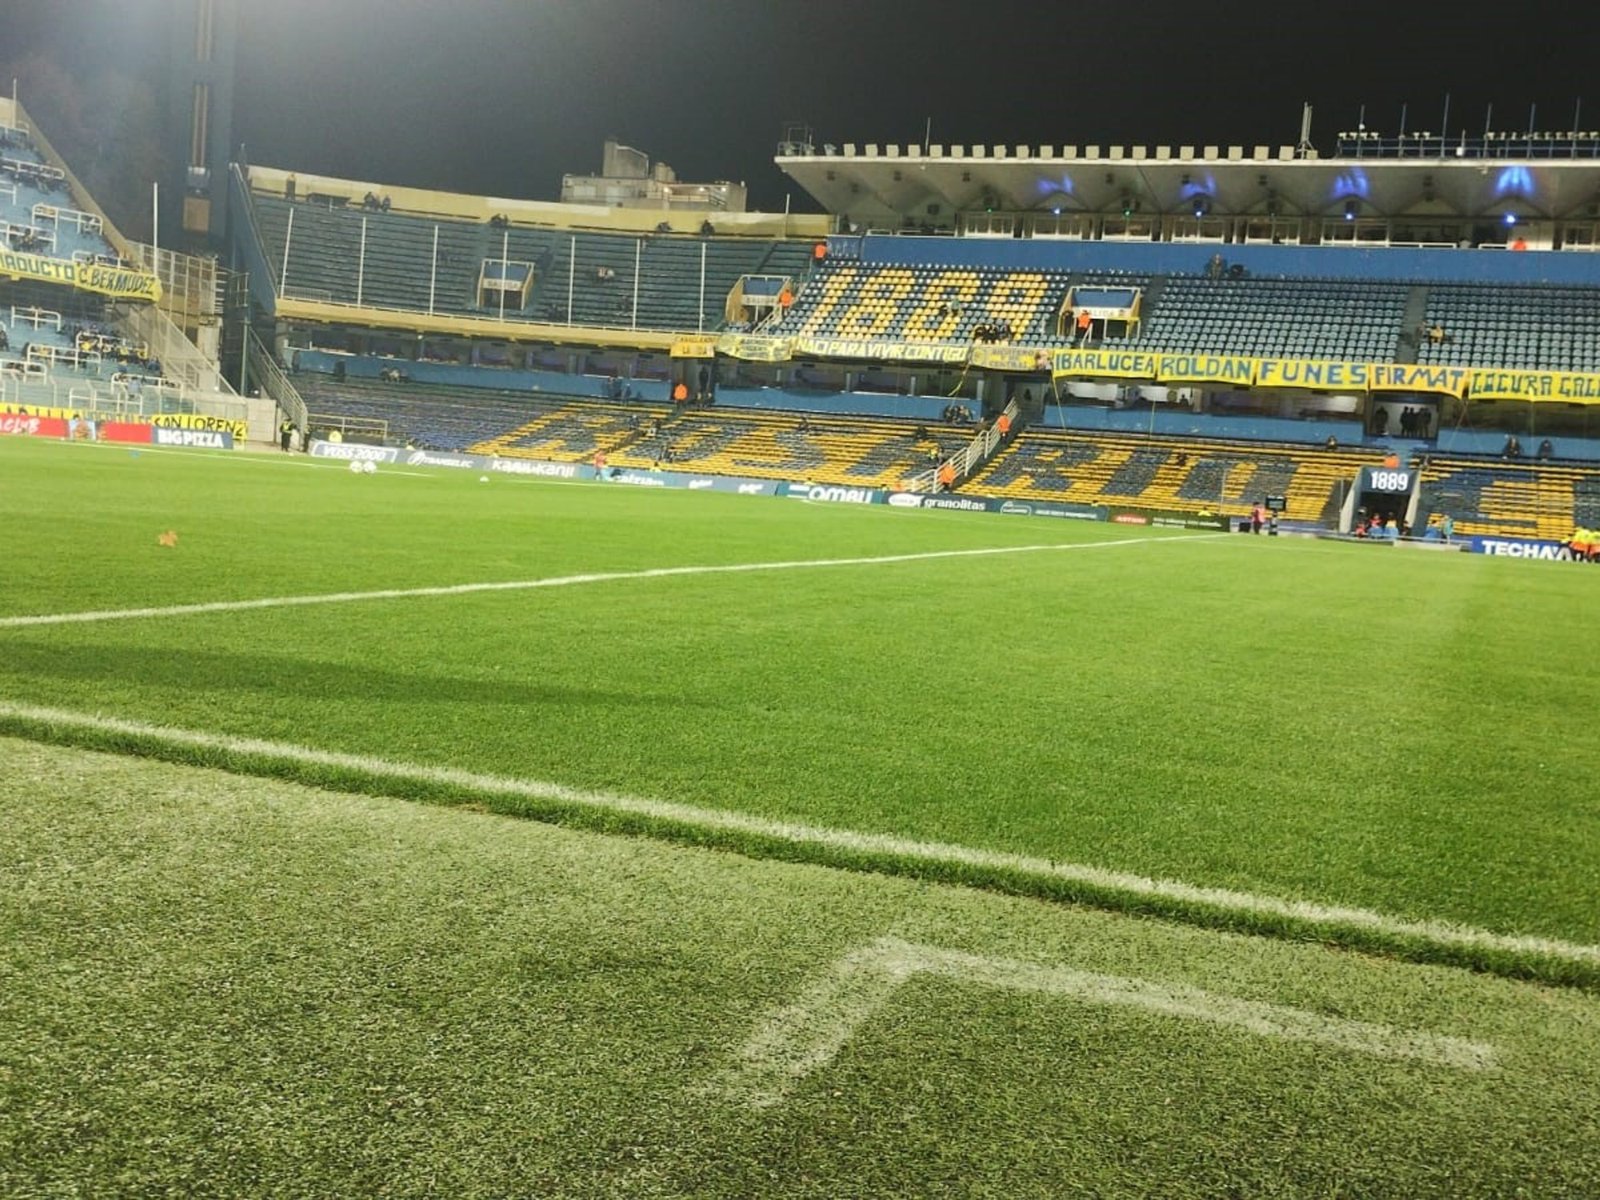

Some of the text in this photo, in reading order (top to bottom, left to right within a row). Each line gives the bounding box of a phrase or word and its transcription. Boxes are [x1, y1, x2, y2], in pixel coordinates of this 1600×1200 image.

[1055, 353, 1155, 374] IBARLUCEA
[1160, 357, 1251, 378] ROLDAN
[1260, 360, 1367, 385] FUNES
[1374, 366, 1464, 391] FIRMAT
[1559, 376, 1600, 397] GAL
[1370, 471, 1409, 491] 1889
